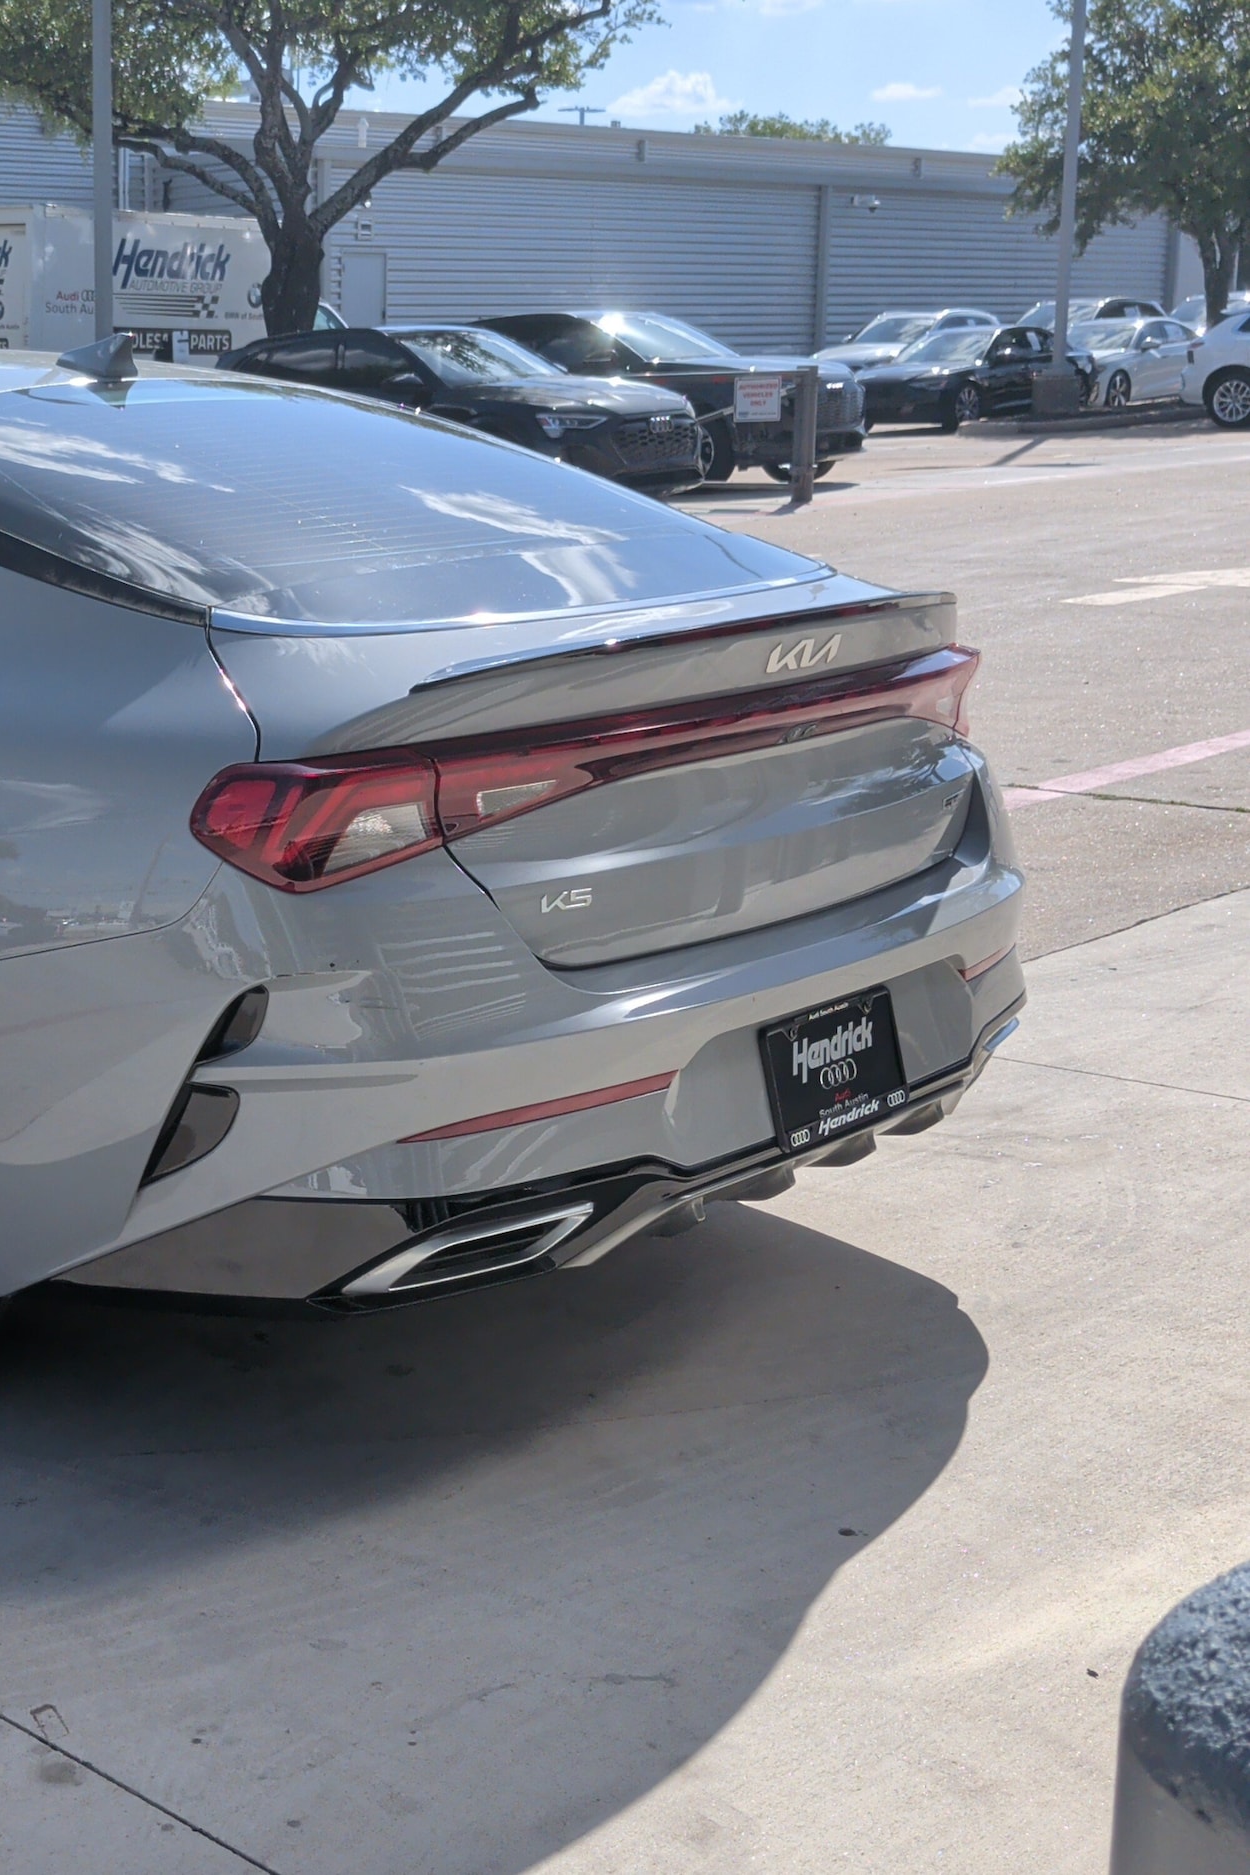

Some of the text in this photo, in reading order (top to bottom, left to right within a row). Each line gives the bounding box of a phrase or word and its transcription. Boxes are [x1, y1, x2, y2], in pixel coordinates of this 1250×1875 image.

[113, 238, 231, 290] Hendrick
[56, 290, 79, 302] Audi
[129, 279, 223, 294] AUTOMOTIVE GROUP
[45, 302, 77, 314] South
[190, 333, 230, 351] PARTS
[540, 887, 593, 914] K5
[792, 1016, 873, 1084] Hendrick
[818, 1092, 869, 1119] South Austin
[818, 1099, 880, 1137] Hendrick
